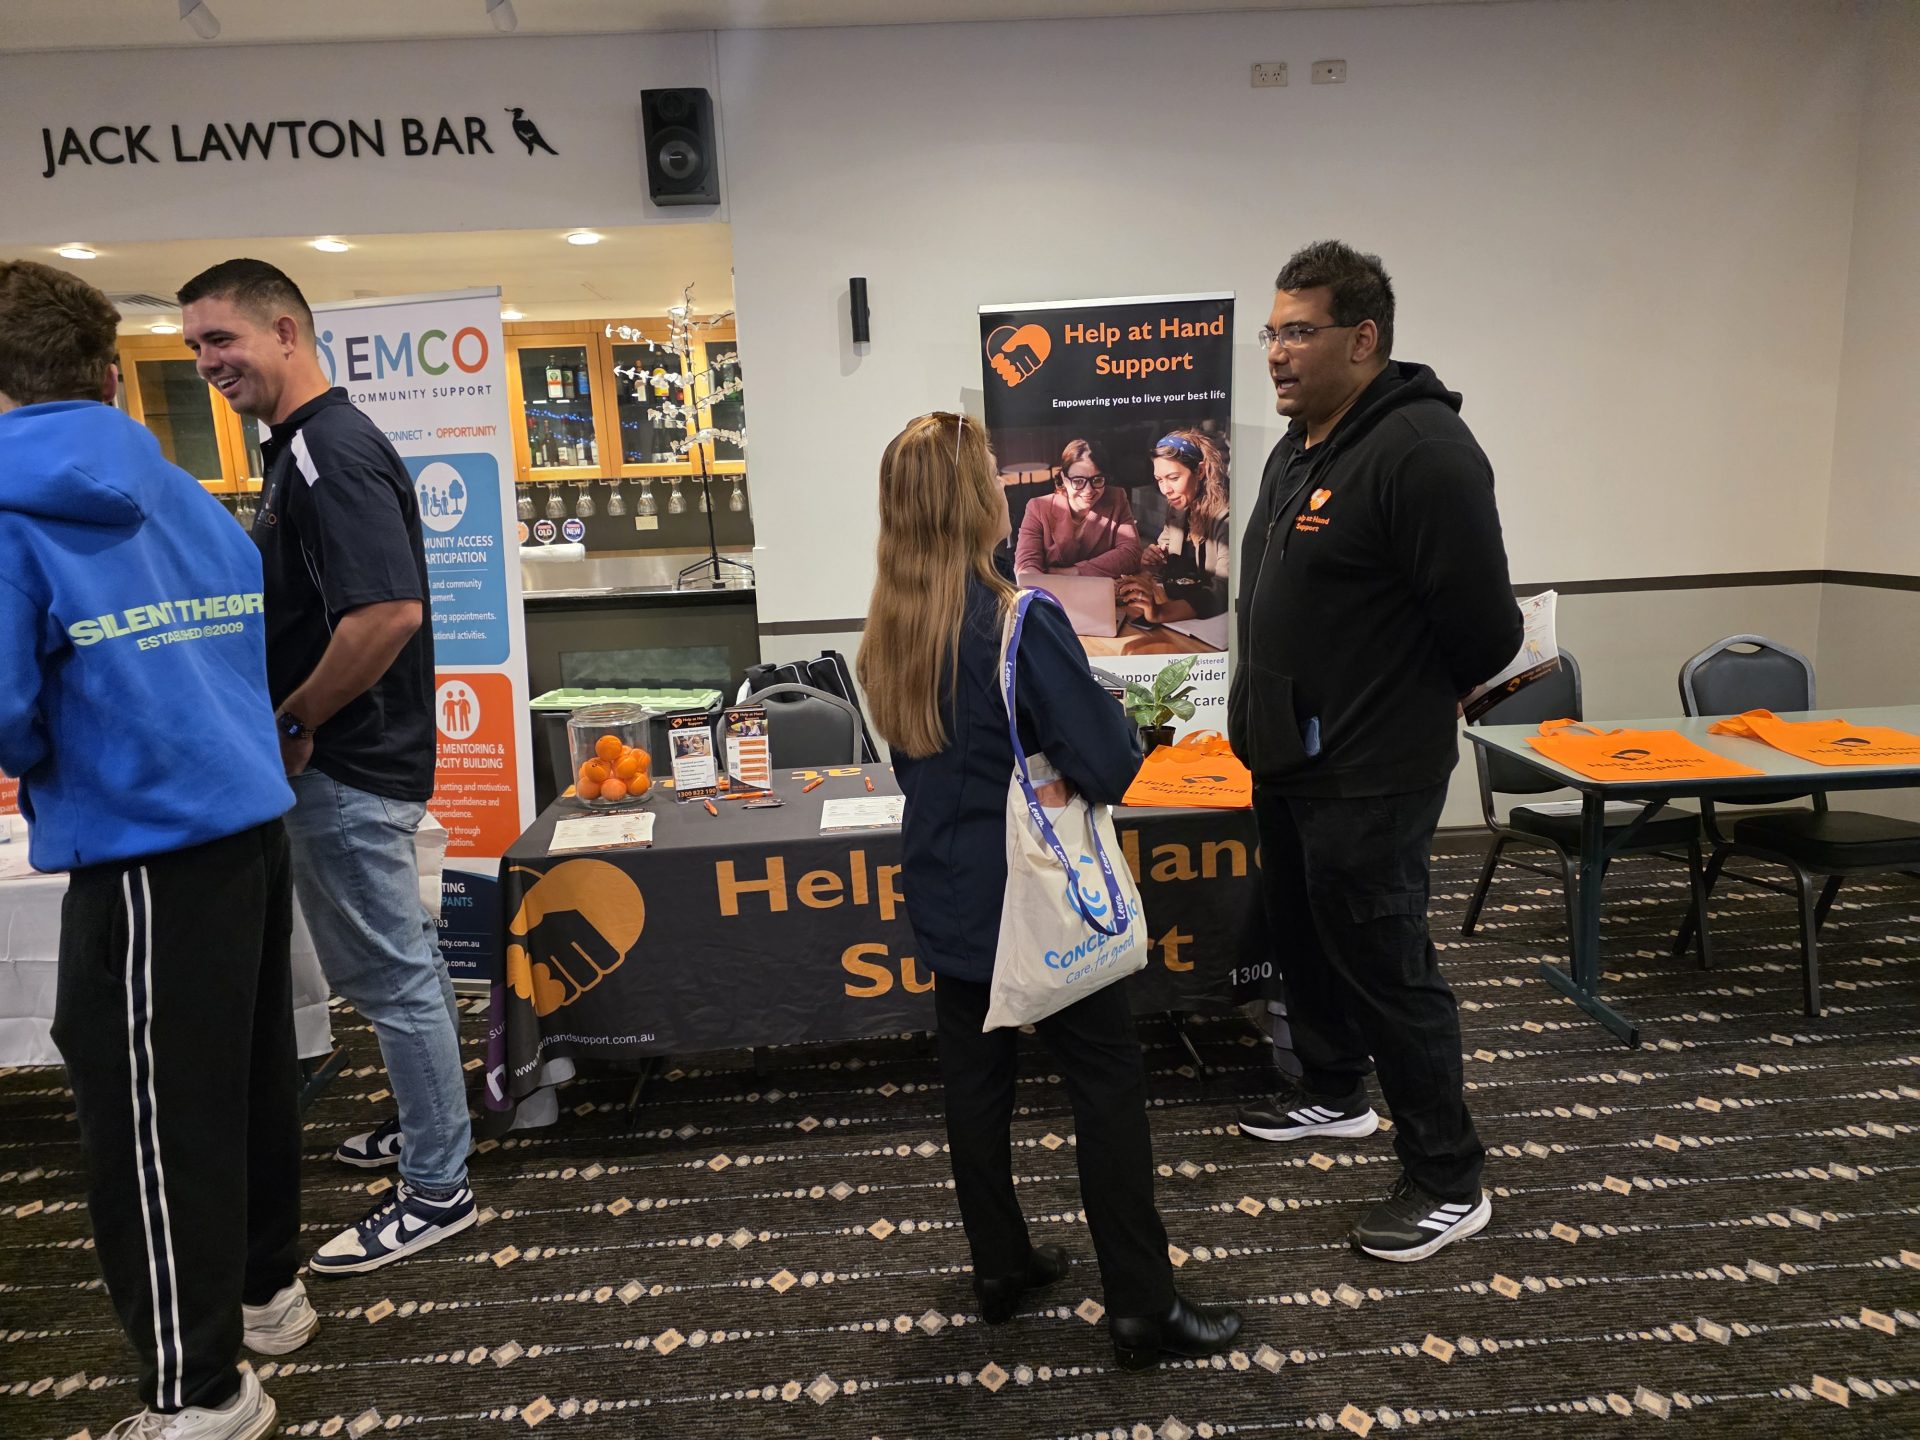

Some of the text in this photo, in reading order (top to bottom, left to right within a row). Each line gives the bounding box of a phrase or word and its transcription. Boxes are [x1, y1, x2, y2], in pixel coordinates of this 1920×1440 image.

[41, 117, 495, 178] JACK LAWTON BAR
[1064, 315, 1224, 348] Help at Hand
[345, 326, 489, 382] EMCO
[1095, 352, 1194, 379] Support
[351, 385, 492, 404] COMMUNITY SUPPORT
[1052, 390, 1226, 408] Empowering you to live your best life
[436, 425, 497, 439] OPPORTUNITY
[537, 529, 553, 537] OLD
[423, 535, 493, 548] MUNITY ACCESS
[424, 551, 487, 565] ARTICIPATION
[432, 579, 445, 589] and
[446, 578, 482, 590] community
[430, 593, 456, 605] gement.
[68, 592, 265, 646] SILENT THEØR
[431, 611, 497, 624] ding appointments.
[433, 630, 487, 640] ational activities.
[1195, 657, 1225, 667] gistered
[1005, 660, 1013, 688] Leora
[1185, 669, 1226, 681] ovider
[1194, 696, 1225, 706] care
[443, 743, 496, 754] MENTORING
[497, 743, 505, 754] &
[436, 757, 503, 769] ACITY BUILDING
[440, 782, 463, 793] setting
[463, 782, 476, 791] and
[477, 783, 512, 792] motivation.
[452, 796, 487, 806] confidence
[488, 797, 500, 807] and
[431, 808, 473, 820] dependence.
[1028, 801, 1045, 828] Leora
[455, 825, 481, 837] through
[446, 837, 475, 847] nsitions.
[1054, 845, 1070, 870] Leora
[1100, 850, 1112, 875] Leora
[441, 882, 466, 894] TING
[441, 896, 473, 907] PANTS
[1116, 893, 1126, 920] Leora
[435, 919, 449, 928] 103
[1044, 897, 1138, 970] CONCENIC
[439, 938, 480, 949] nity.com.au
[1228, 961, 1273, 986] 1300
